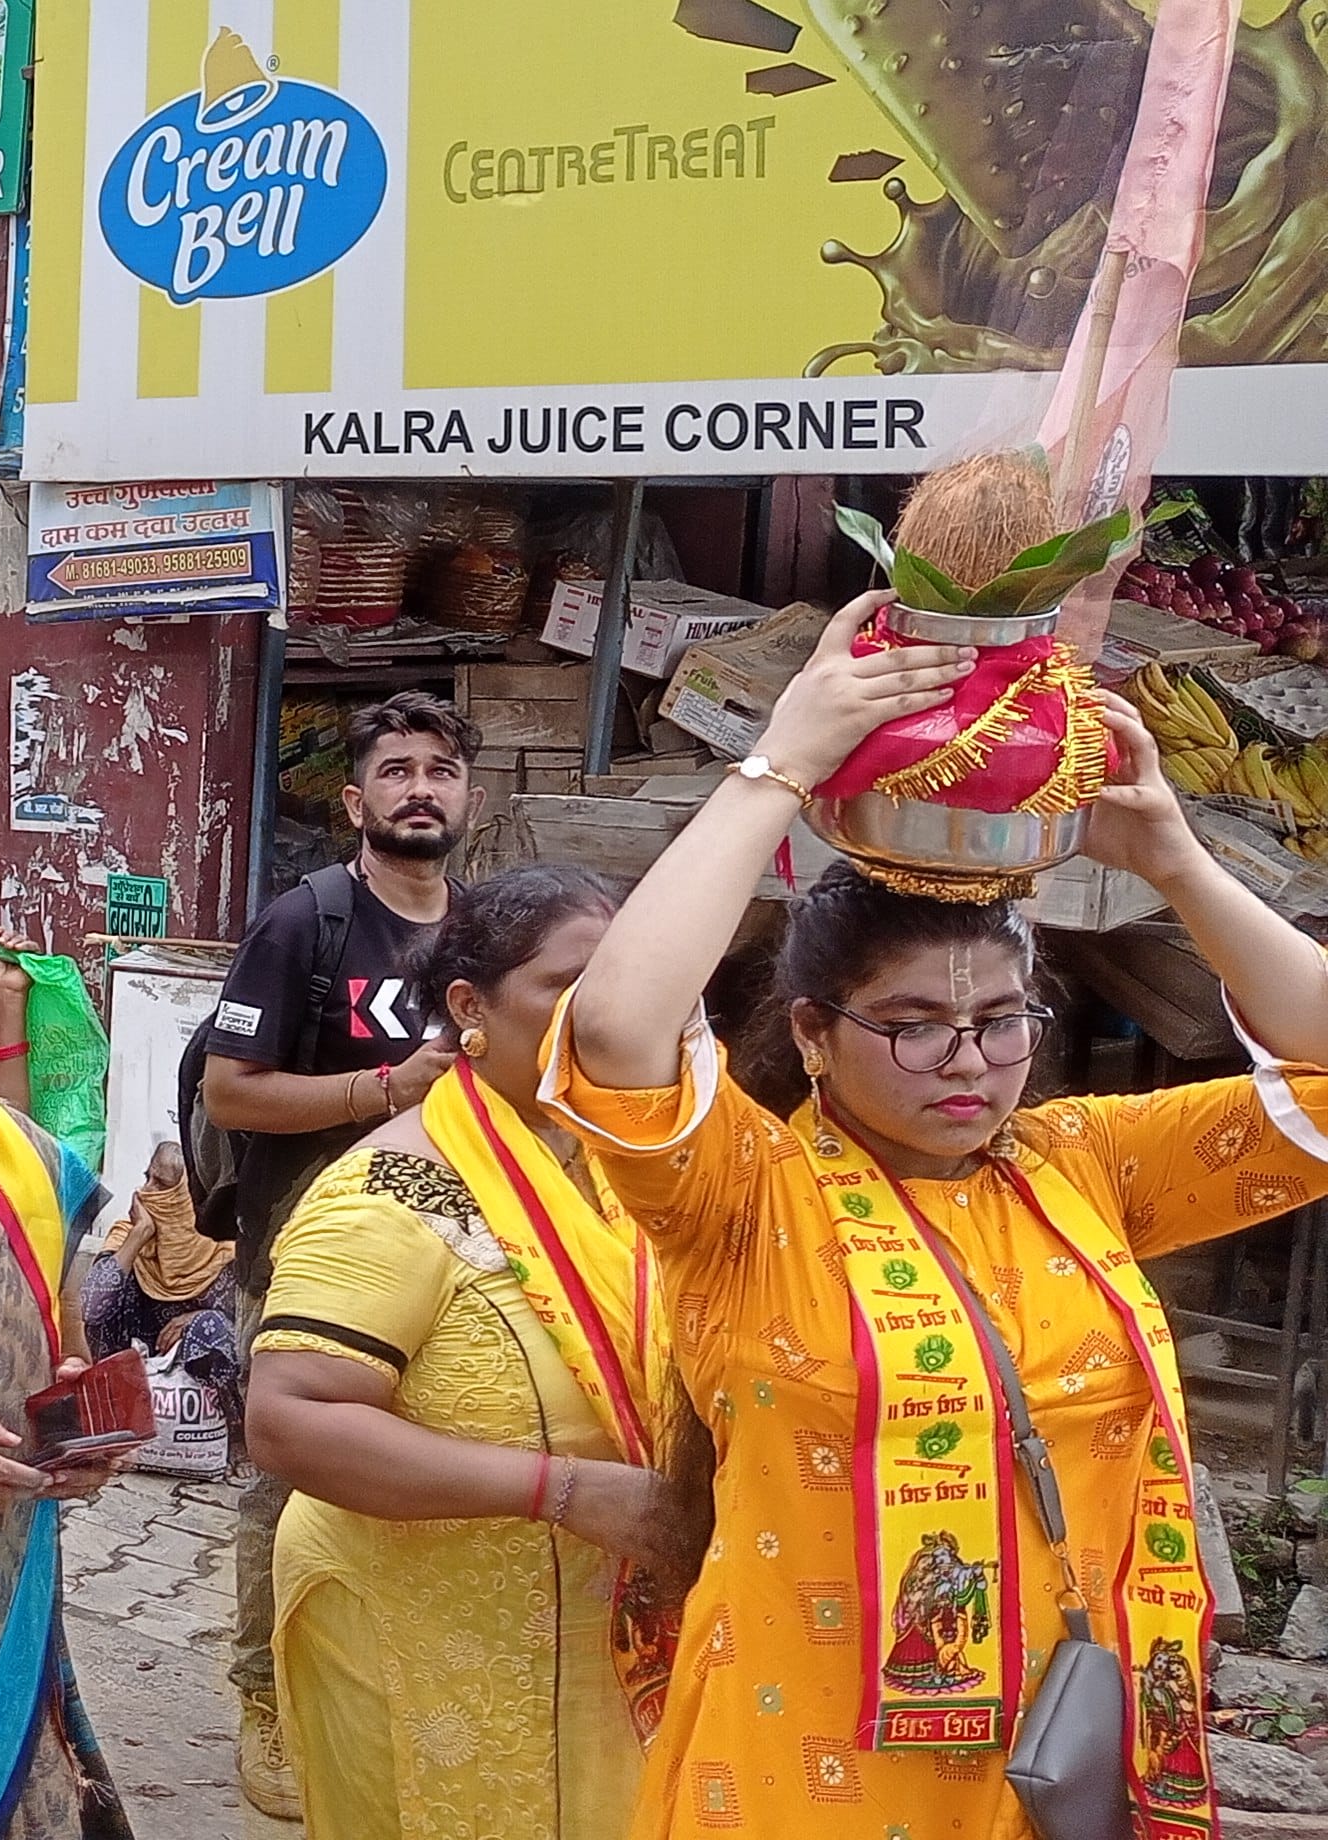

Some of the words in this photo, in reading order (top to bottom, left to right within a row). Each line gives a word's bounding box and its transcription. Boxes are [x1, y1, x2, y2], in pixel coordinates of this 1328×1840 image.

[126, 119, 347, 227] Cream
[172, 185, 304, 294] Bell
[304, 409, 474, 454] KALRA
[487, 406, 645, 454] JUICE
[664, 399, 927, 452] CORNER
[65, 487, 109, 509] उच्च
[134, 516, 176, 538] दवा
[65, 564, 79, 580] M.
[83, 557, 160, 579] 81681-49033,
[164, 550, 246, 572] 95881-25909
[1137, 1585, 1164, 1606] राधे
